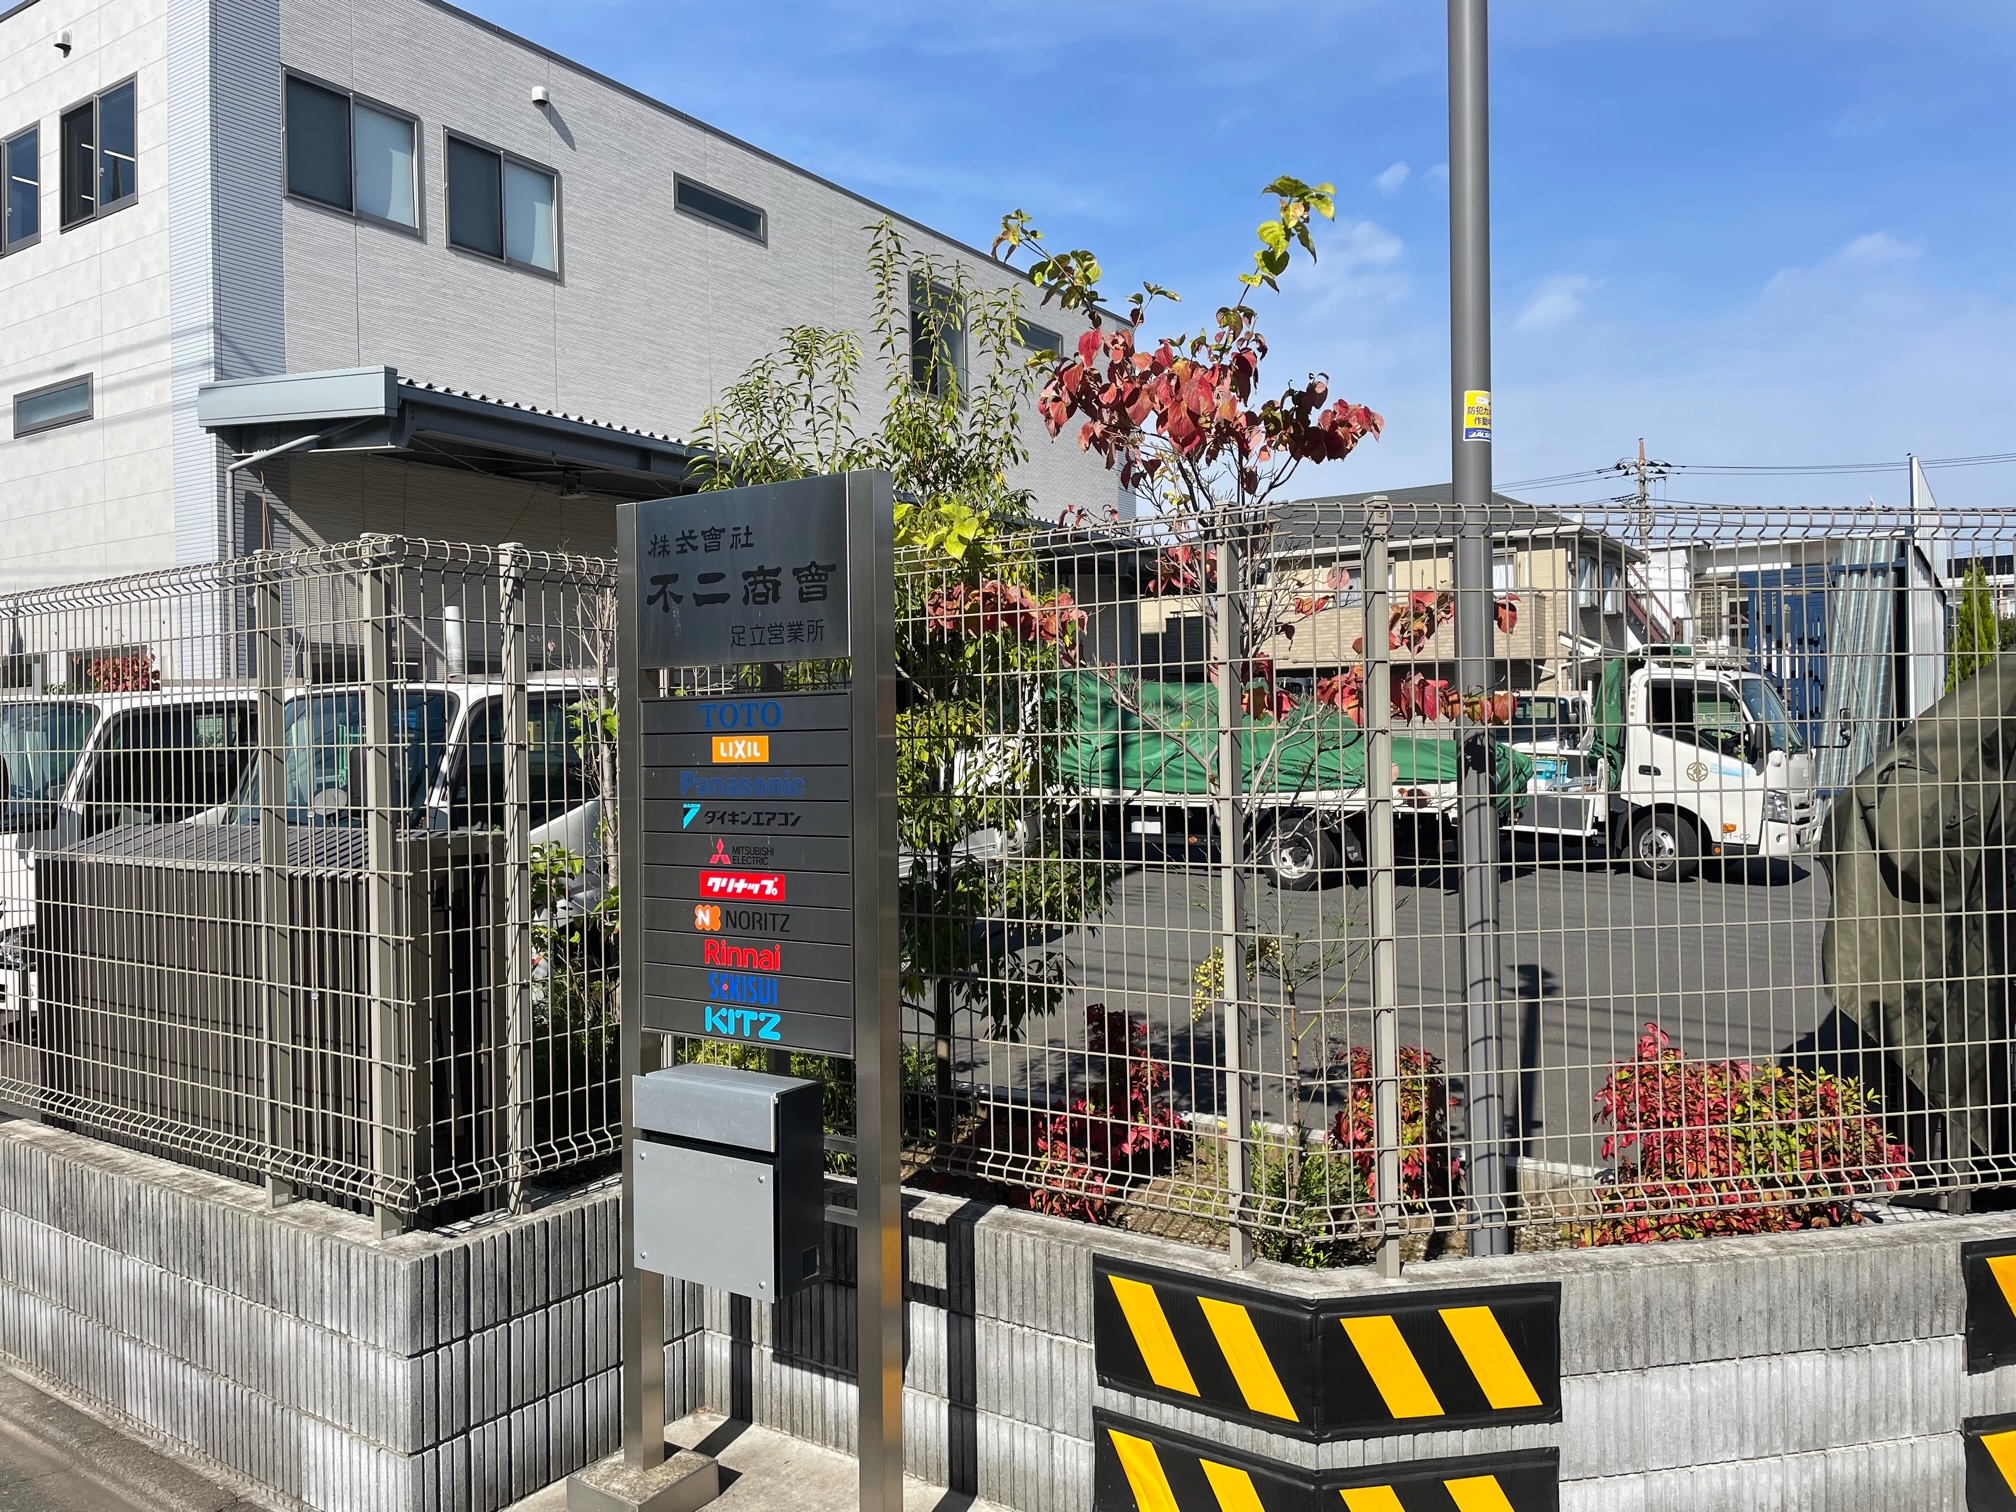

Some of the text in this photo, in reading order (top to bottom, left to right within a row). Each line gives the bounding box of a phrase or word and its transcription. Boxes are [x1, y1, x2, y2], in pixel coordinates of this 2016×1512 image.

[648, 525, 754, 558] 株式會社
[646, 560, 836, 613] 不二商會
[730, 619, 824, 648] 足立営業所
[699, 701, 783, 729] TOTO
[720, 739, 760, 759] LIXIL
[679, 770, 806, 797] Panasonic
[703, 810, 802, 827] ダイキンエアコン
[732, 846, 775, 857] MITSUBISHI
[732, 856, 769, 866] ELECTRIC
[707, 876, 779, 896] クリナップ
[725, 910, 790, 932] NORITZ
[704, 939, 781, 971] Rinnai
[708, 972, 778, 1006] SEKISUI
[704, 1005, 781, 1041] KITZ
